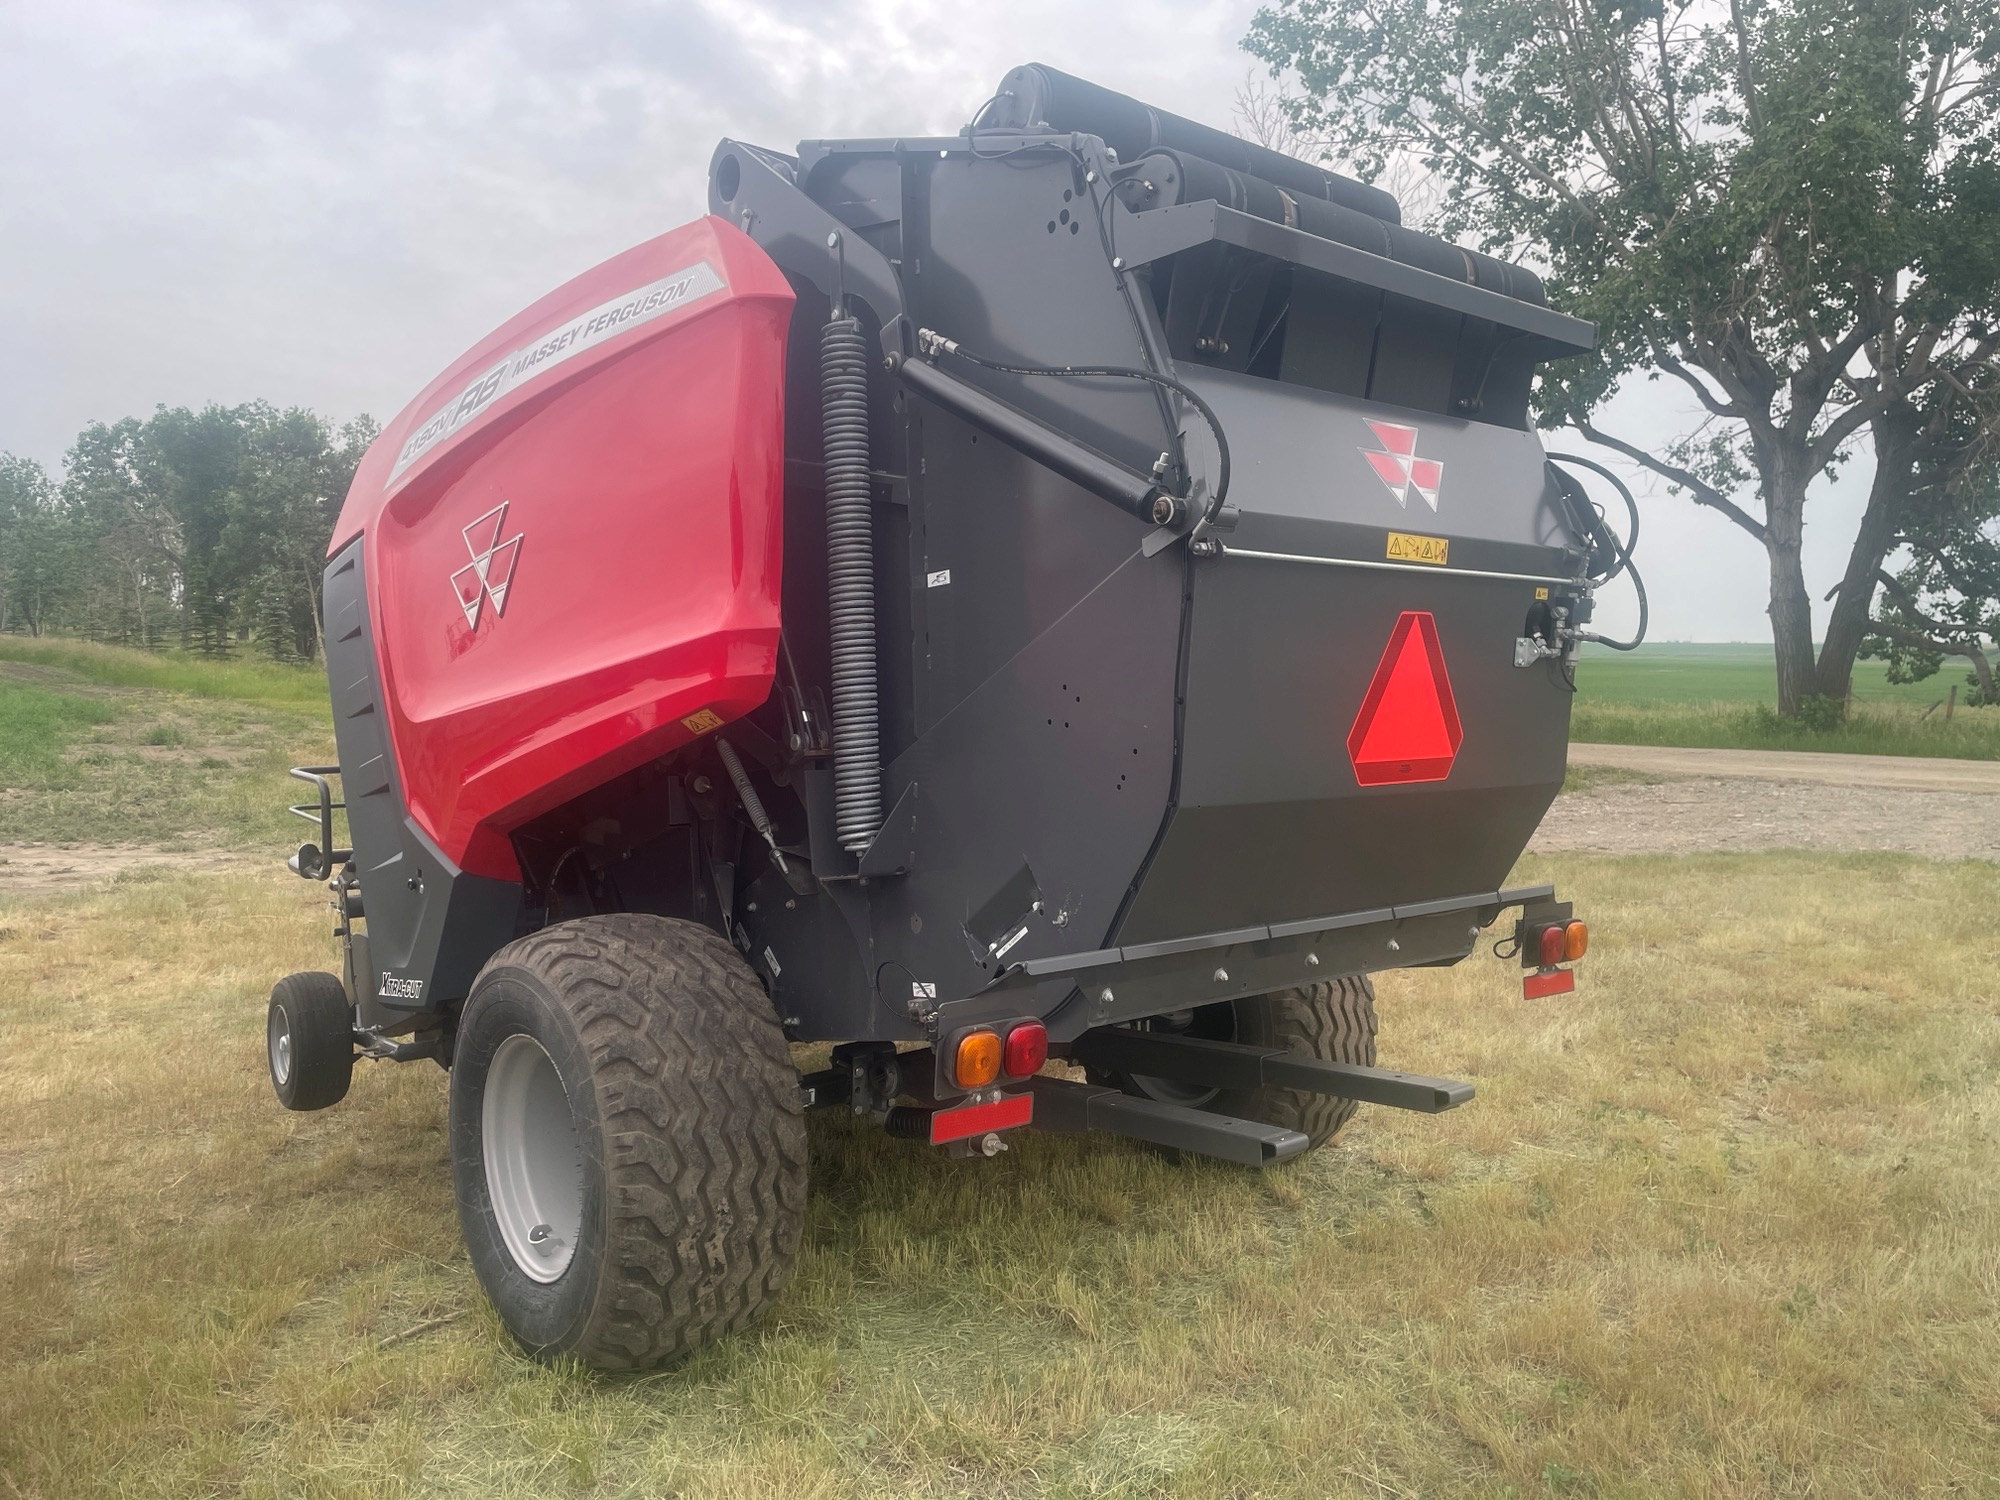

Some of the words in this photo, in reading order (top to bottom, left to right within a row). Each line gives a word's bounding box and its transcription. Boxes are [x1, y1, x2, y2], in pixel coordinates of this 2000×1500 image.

[450, 362, 509, 427] RB
[512, 326, 582, 378] MASSEY
[584, 278, 694, 338] FERGUSON
